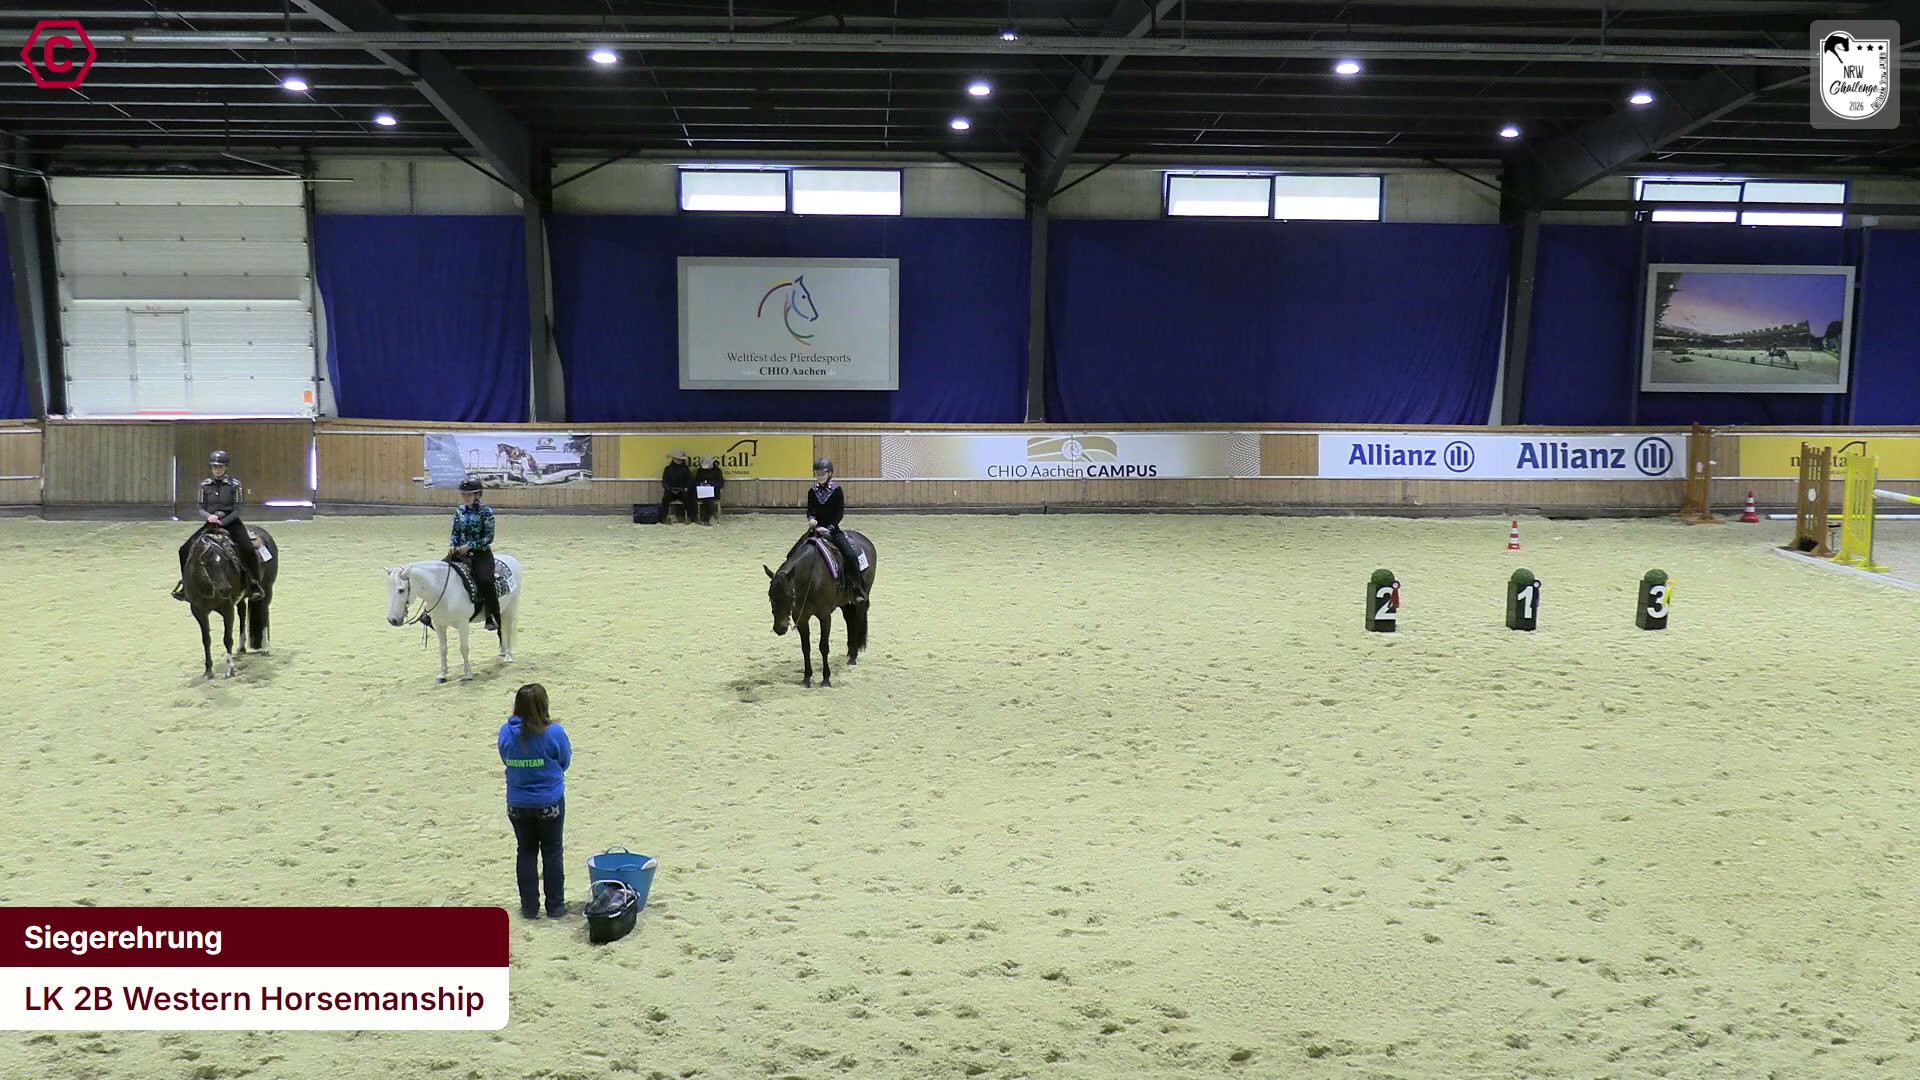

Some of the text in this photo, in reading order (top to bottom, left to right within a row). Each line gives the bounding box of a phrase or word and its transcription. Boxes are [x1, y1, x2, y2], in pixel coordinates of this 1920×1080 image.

[727, 352, 852, 365] Weltfest des Pferdesports
[759, 367, 789, 376] CHIO
[791, 367, 827, 376] Aachen
[686, 452, 749, 467] atall
[1348, 443, 1437, 466] Allianz
[1516, 442, 1627, 469] Allianz
[987, 464, 1157, 478] CHIO Aachen CAMPUS
[1374, 586, 1397, 620] 2
[1517, 585, 1534, 619] 1
[1647, 585, 1669, 619] 3
